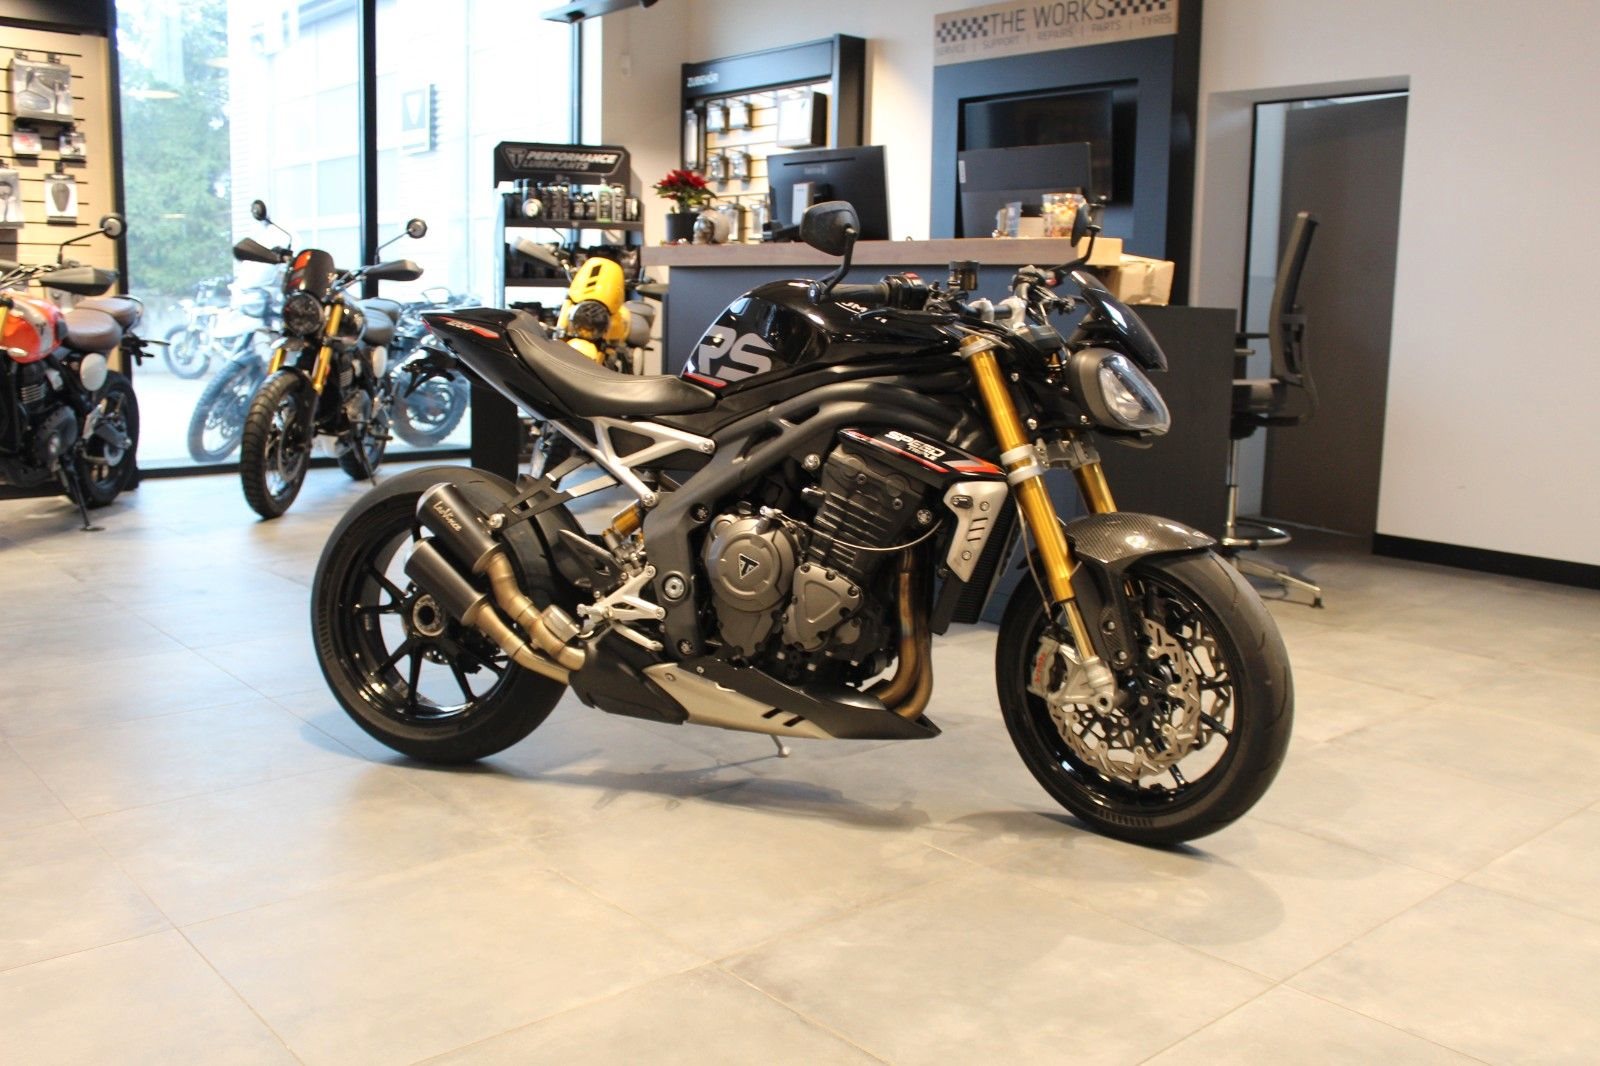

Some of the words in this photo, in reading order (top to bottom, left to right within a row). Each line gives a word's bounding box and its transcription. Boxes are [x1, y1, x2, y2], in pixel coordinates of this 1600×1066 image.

[990, 8, 1027, 34] THE
[1033, 0, 1108, 29] WORKS
[982, 36, 1021, 49] SUPPORT
[1091, 21, 1121, 31] PARTS
[1141, 14, 1173, 26] TYRES
[522, 160, 590, 171] LUBRICANTS
[526, 150, 619, 165] PERFORMANCE
[884, 430, 946, 458] SPEED
